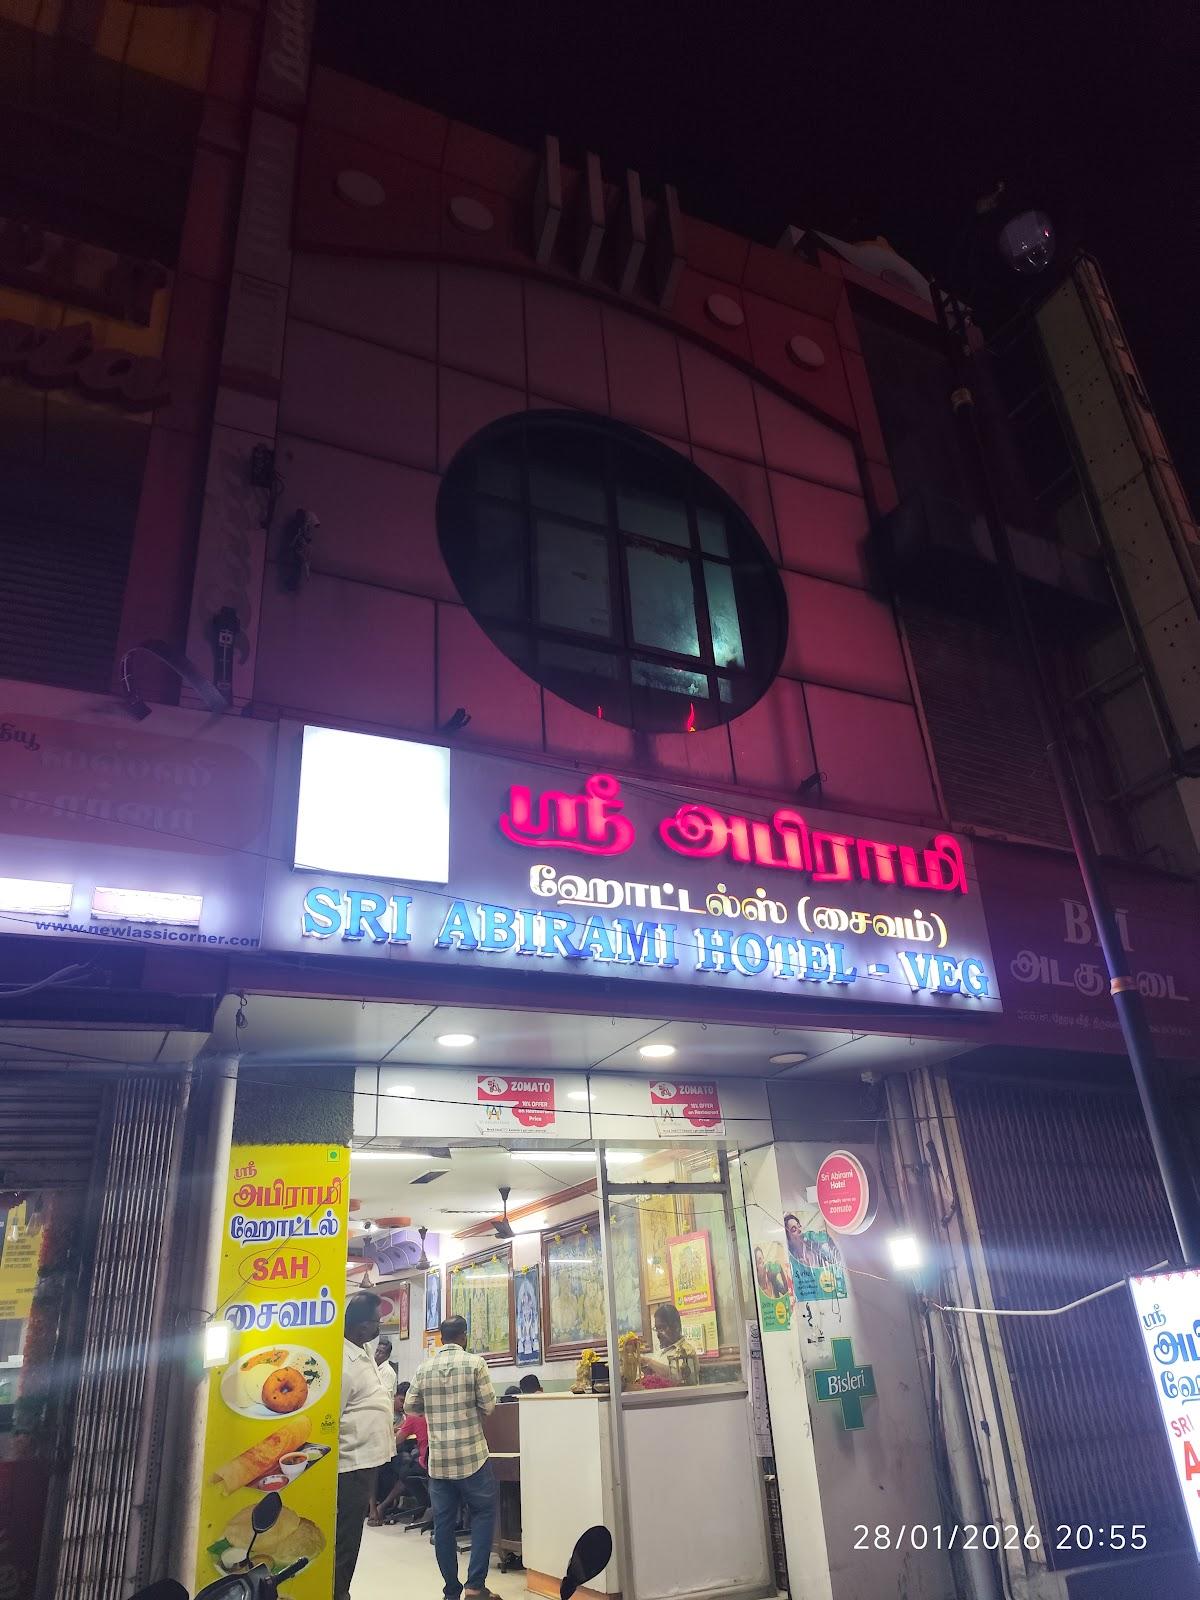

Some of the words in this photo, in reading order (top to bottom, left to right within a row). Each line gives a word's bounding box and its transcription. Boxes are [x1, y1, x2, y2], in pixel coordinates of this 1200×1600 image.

[659, 801, 970, 895] அபிராமி
[529, 864, 788, 926] ஹோட்டல்ஸ்
[797, 894, 949, 949] (சைவம்)
[1062, 898, 1135, 952] BI
[301, 885, 413, 945] SRI
[437, 900, 679, 968] ABIRAMI
[692, 925, 858, 986] HOTEL
[897, 949, 992, 998] VEG
[511, 1081, 551, 1093] ZOMATO
[680, 1085, 714, 1096] ZOMATO
[830, 1170, 853, 1180] Abirami
[830, 1180, 846, 1189] Hotel
[233, 1176, 342, 1210] அபிராமி
[830, 1205, 852, 1213] zomato
[231, 1210, 338, 1244] ஹோட்டல்
[252, 1255, 309, 1281] SAH
[225, 1287, 336, 1331] சைவம்
[828, 1369, 865, 1395] Bisleri
[1171, 1413, 1195, 1438] SRI
[1183, 1440, 1200, 1481] A
